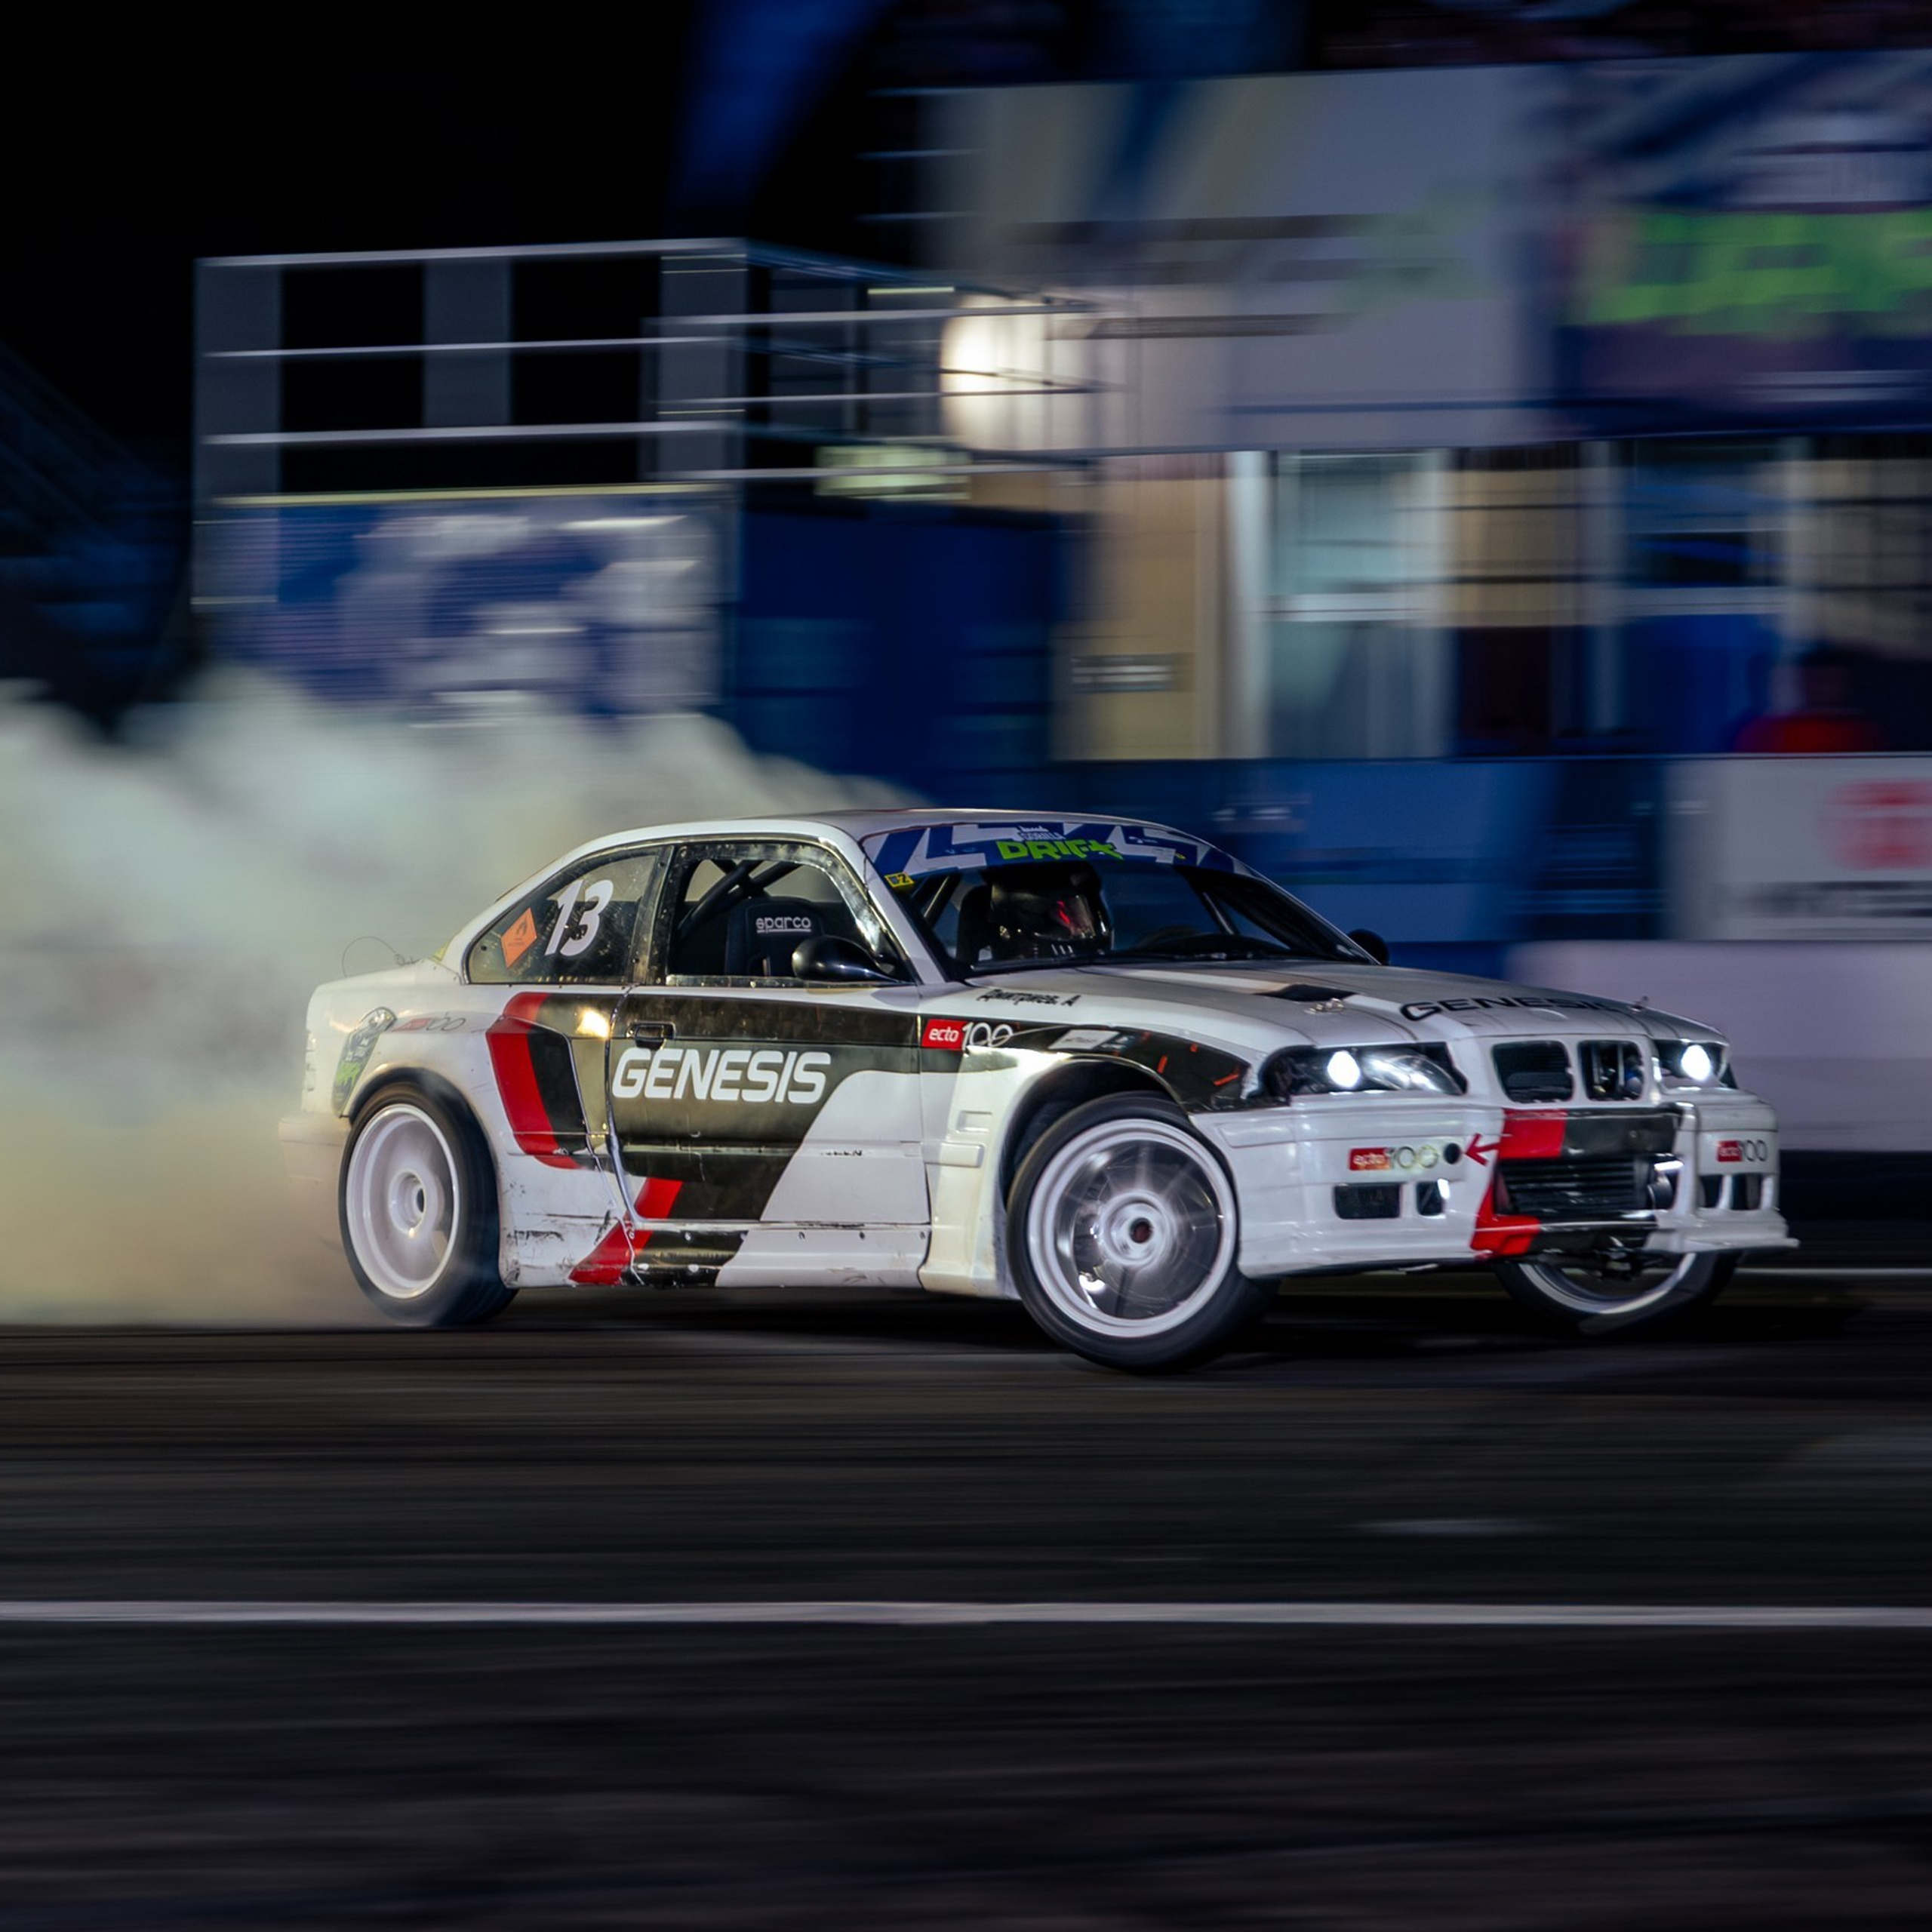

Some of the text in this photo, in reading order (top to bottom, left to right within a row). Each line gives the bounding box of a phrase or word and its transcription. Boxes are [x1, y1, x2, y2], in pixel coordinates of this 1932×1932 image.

[996, 839, 1124, 860] DRIFT
[545, 879, 614, 956] 13
[756, 917, 811, 934] sparco
[612, 1048, 831, 1104] GENESIS
